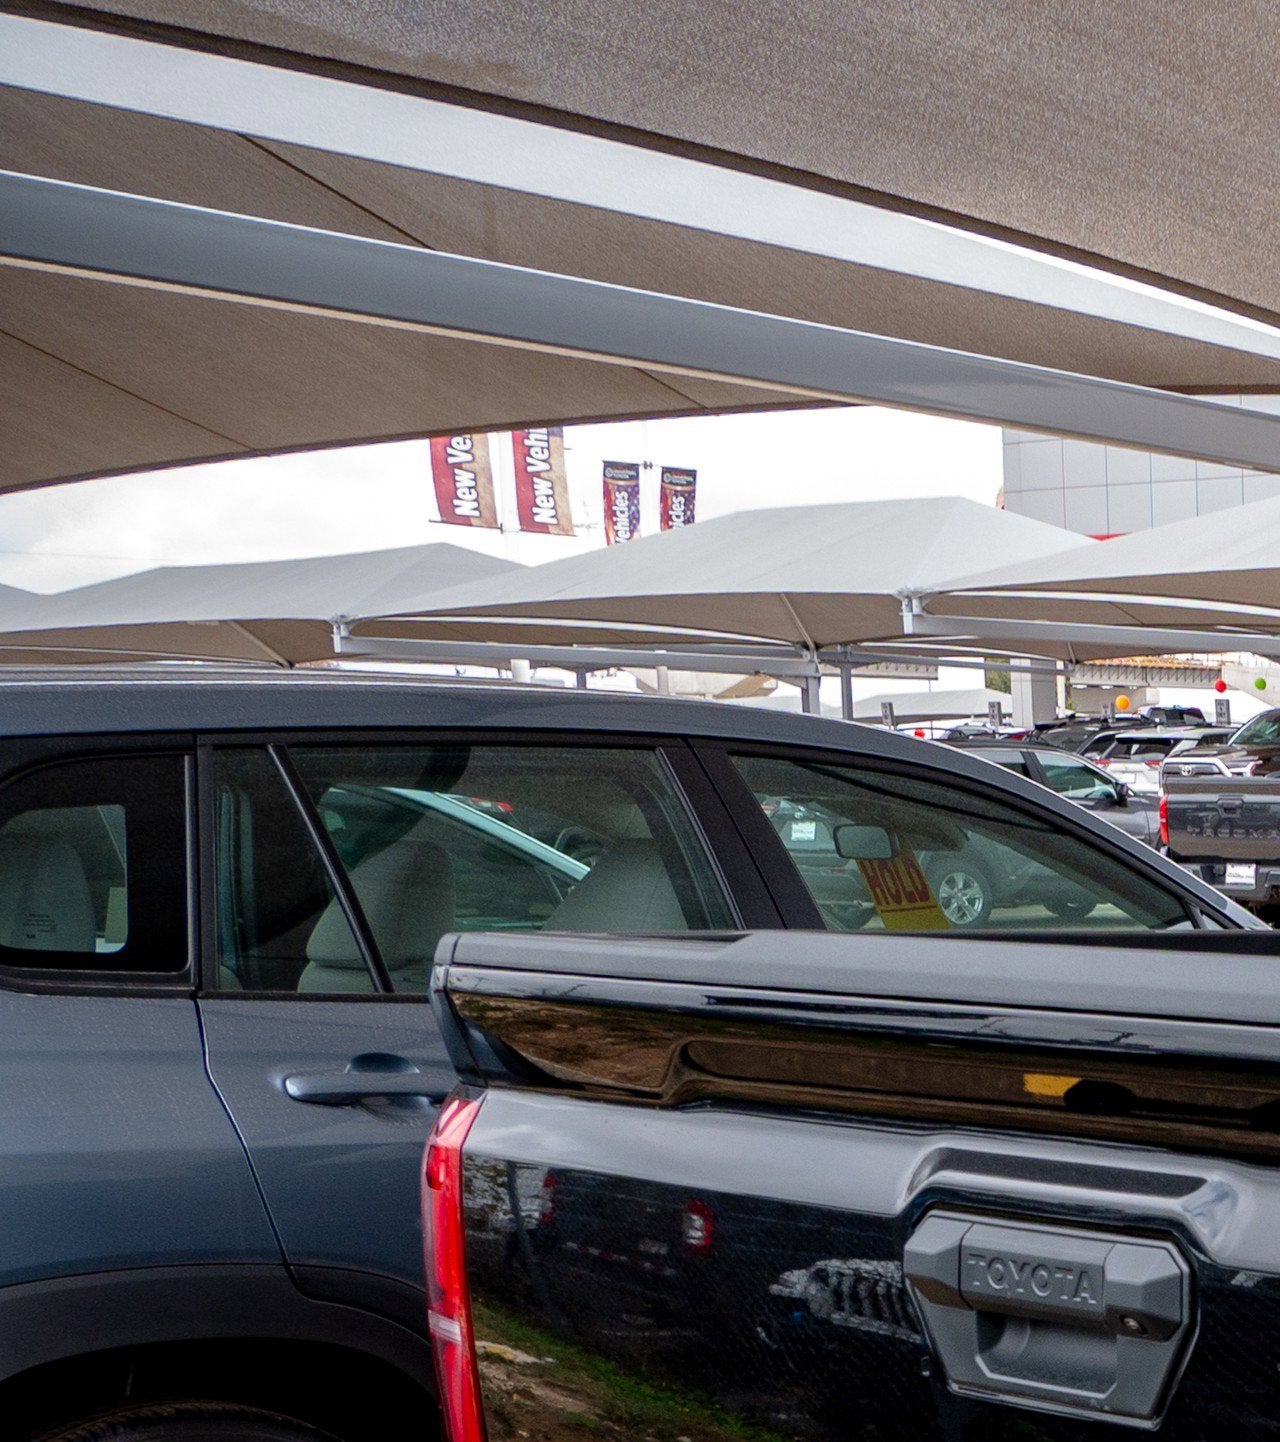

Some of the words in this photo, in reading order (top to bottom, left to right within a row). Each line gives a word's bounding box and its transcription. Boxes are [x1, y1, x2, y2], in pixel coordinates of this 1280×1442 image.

[446, 434, 474, 465] Ve
[452, 468, 481, 518] New
[531, 476, 559, 525] New
[858, 857, 930, 905] HOLD
[966, 1253, 1098, 1305] TOYOTA
